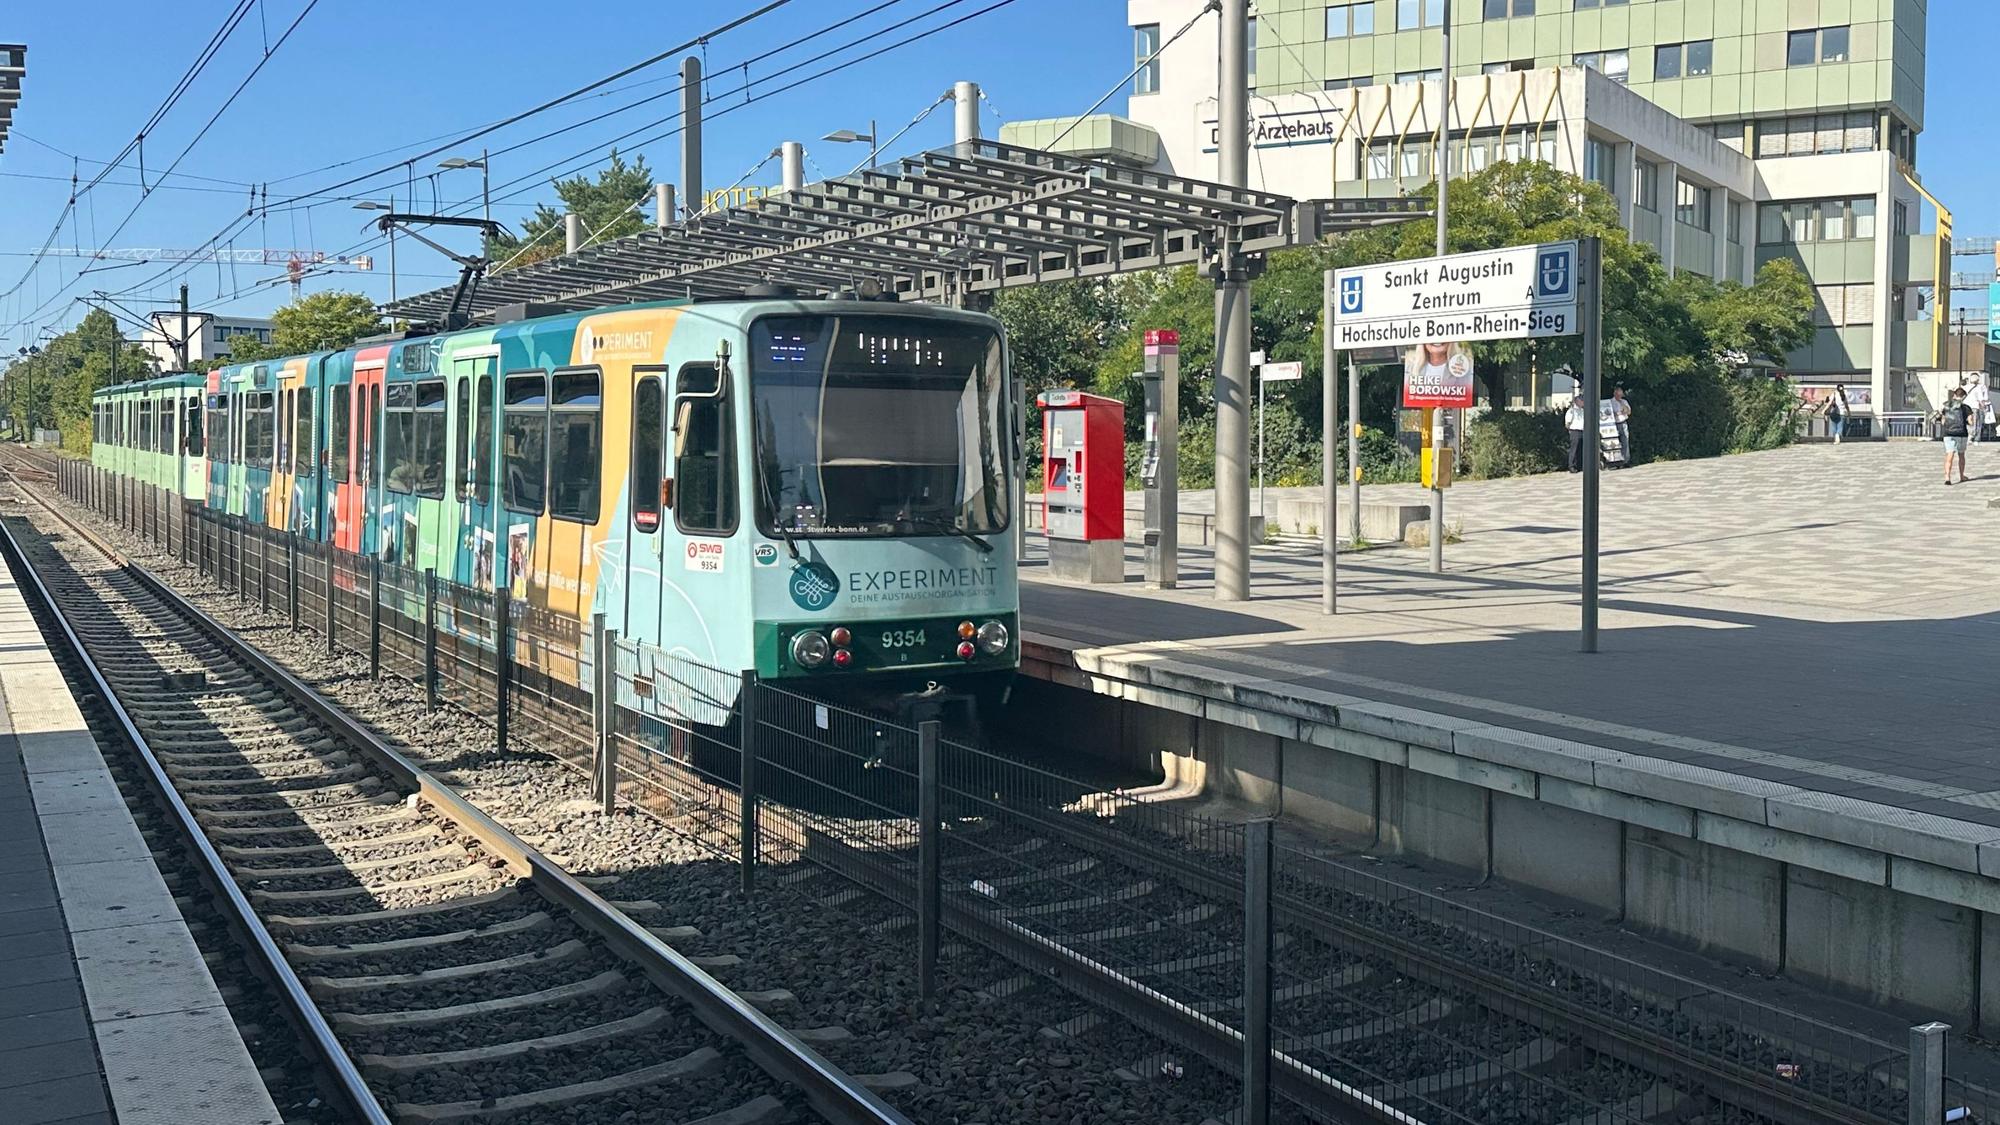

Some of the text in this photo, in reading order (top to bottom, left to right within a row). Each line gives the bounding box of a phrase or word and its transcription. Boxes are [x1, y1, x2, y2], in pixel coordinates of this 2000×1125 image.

[1256, 119, 1333, 141] Ärztehaus
[1384, 258, 1513, 288] Sankt Augustin
[1525, 285, 1535, 300] A
[1412, 291, 1481, 310] Zentrum
[1342, 309, 1565, 343] Hochschule Bonn-Rhein-Sieg
[1409, 375, 1441, 385] HEIKE
[1409, 385, 1466, 396] BOROWSKI
[699, 543, 722, 554] SWB
[755, 548, 772, 556] VRS
[701, 560, 718, 570] 9354
[850, 567, 997, 591] EXPERIMENT
[850, 594, 878, 604] DEINE
[881, 630, 926, 648] 9354
[901, 654, 907, 662] B
